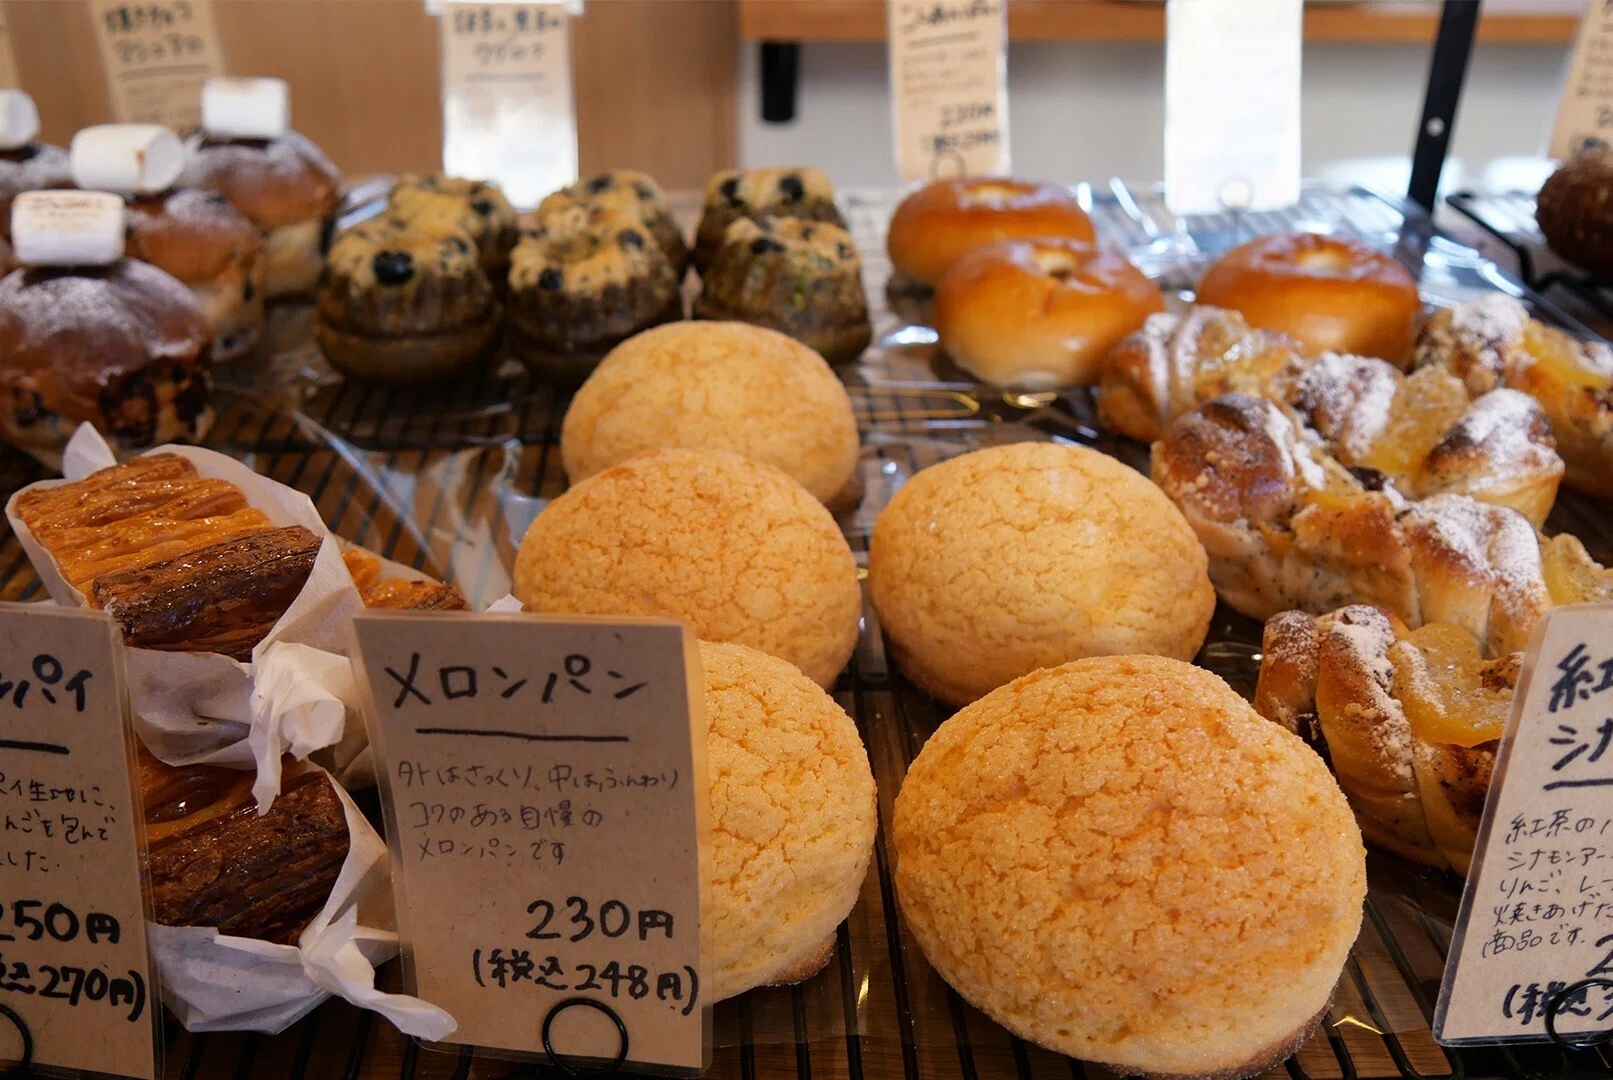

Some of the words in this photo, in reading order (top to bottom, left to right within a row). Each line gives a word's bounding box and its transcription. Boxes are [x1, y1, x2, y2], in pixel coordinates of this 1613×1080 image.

[384, 652, 648, 708] メロンパン
[410, 799, 603, 831] コクのある自慢の
[1507, 847, 1613, 871] シナモンアー
[526, 896, 674, 943] 230円
[0, 953, 146, 1022] 込270円)
[473, 948, 699, 1016] (税込248円)
